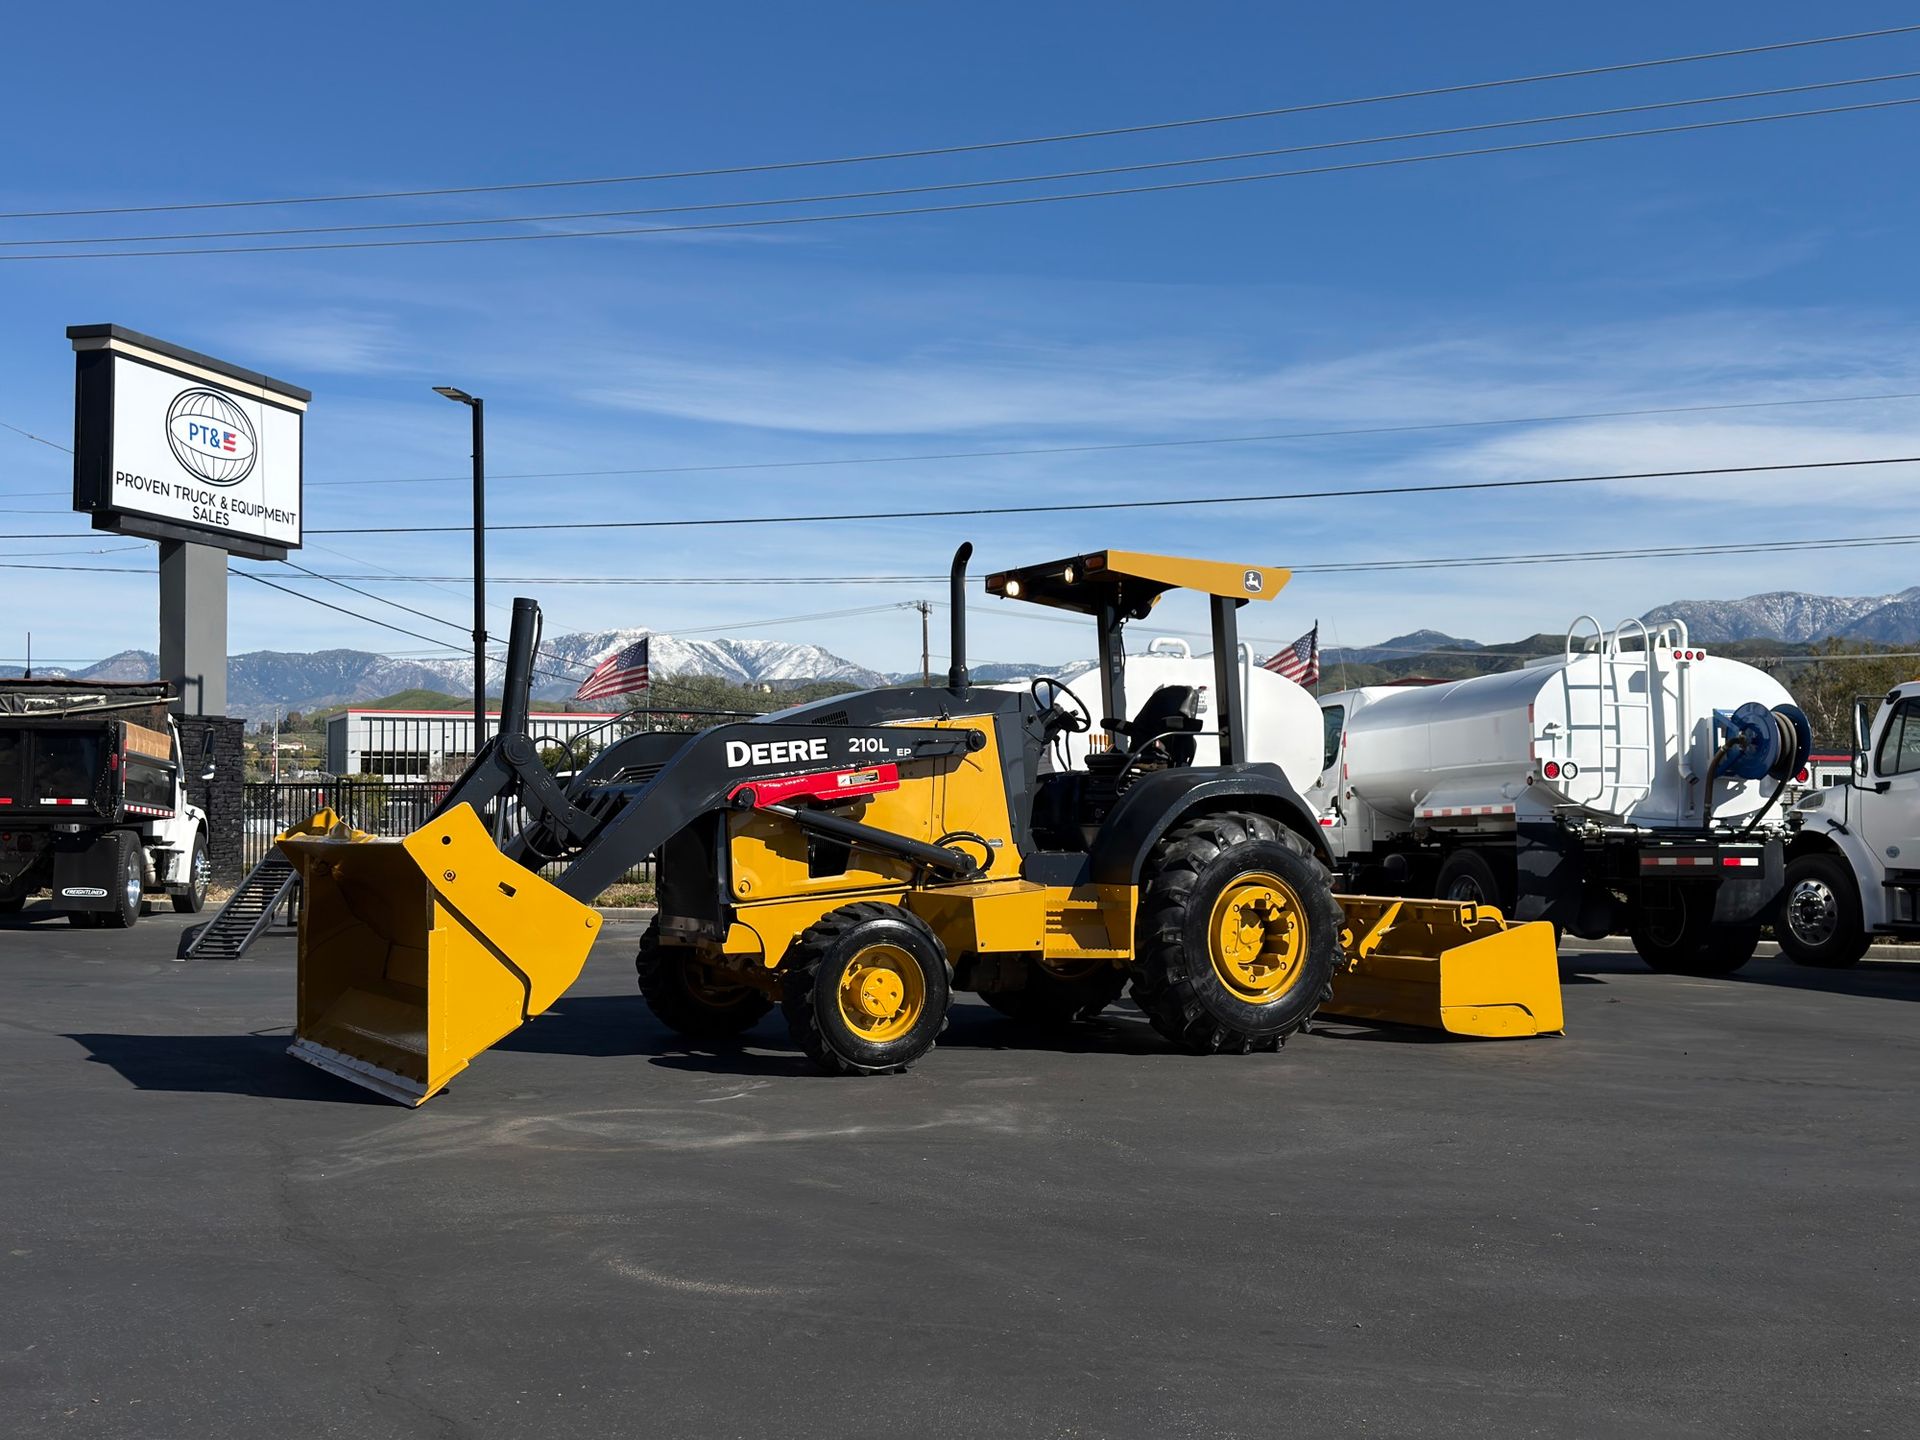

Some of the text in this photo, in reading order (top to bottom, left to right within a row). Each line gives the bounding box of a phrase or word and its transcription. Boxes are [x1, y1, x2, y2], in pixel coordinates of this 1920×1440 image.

[188, 421, 237, 453] PT&E
[115, 471, 297, 526] PROVEN TRUCK & EQUIPMENT
[192, 505, 230, 526] SALES
[725, 737, 912, 769] DEERE 210L EP
